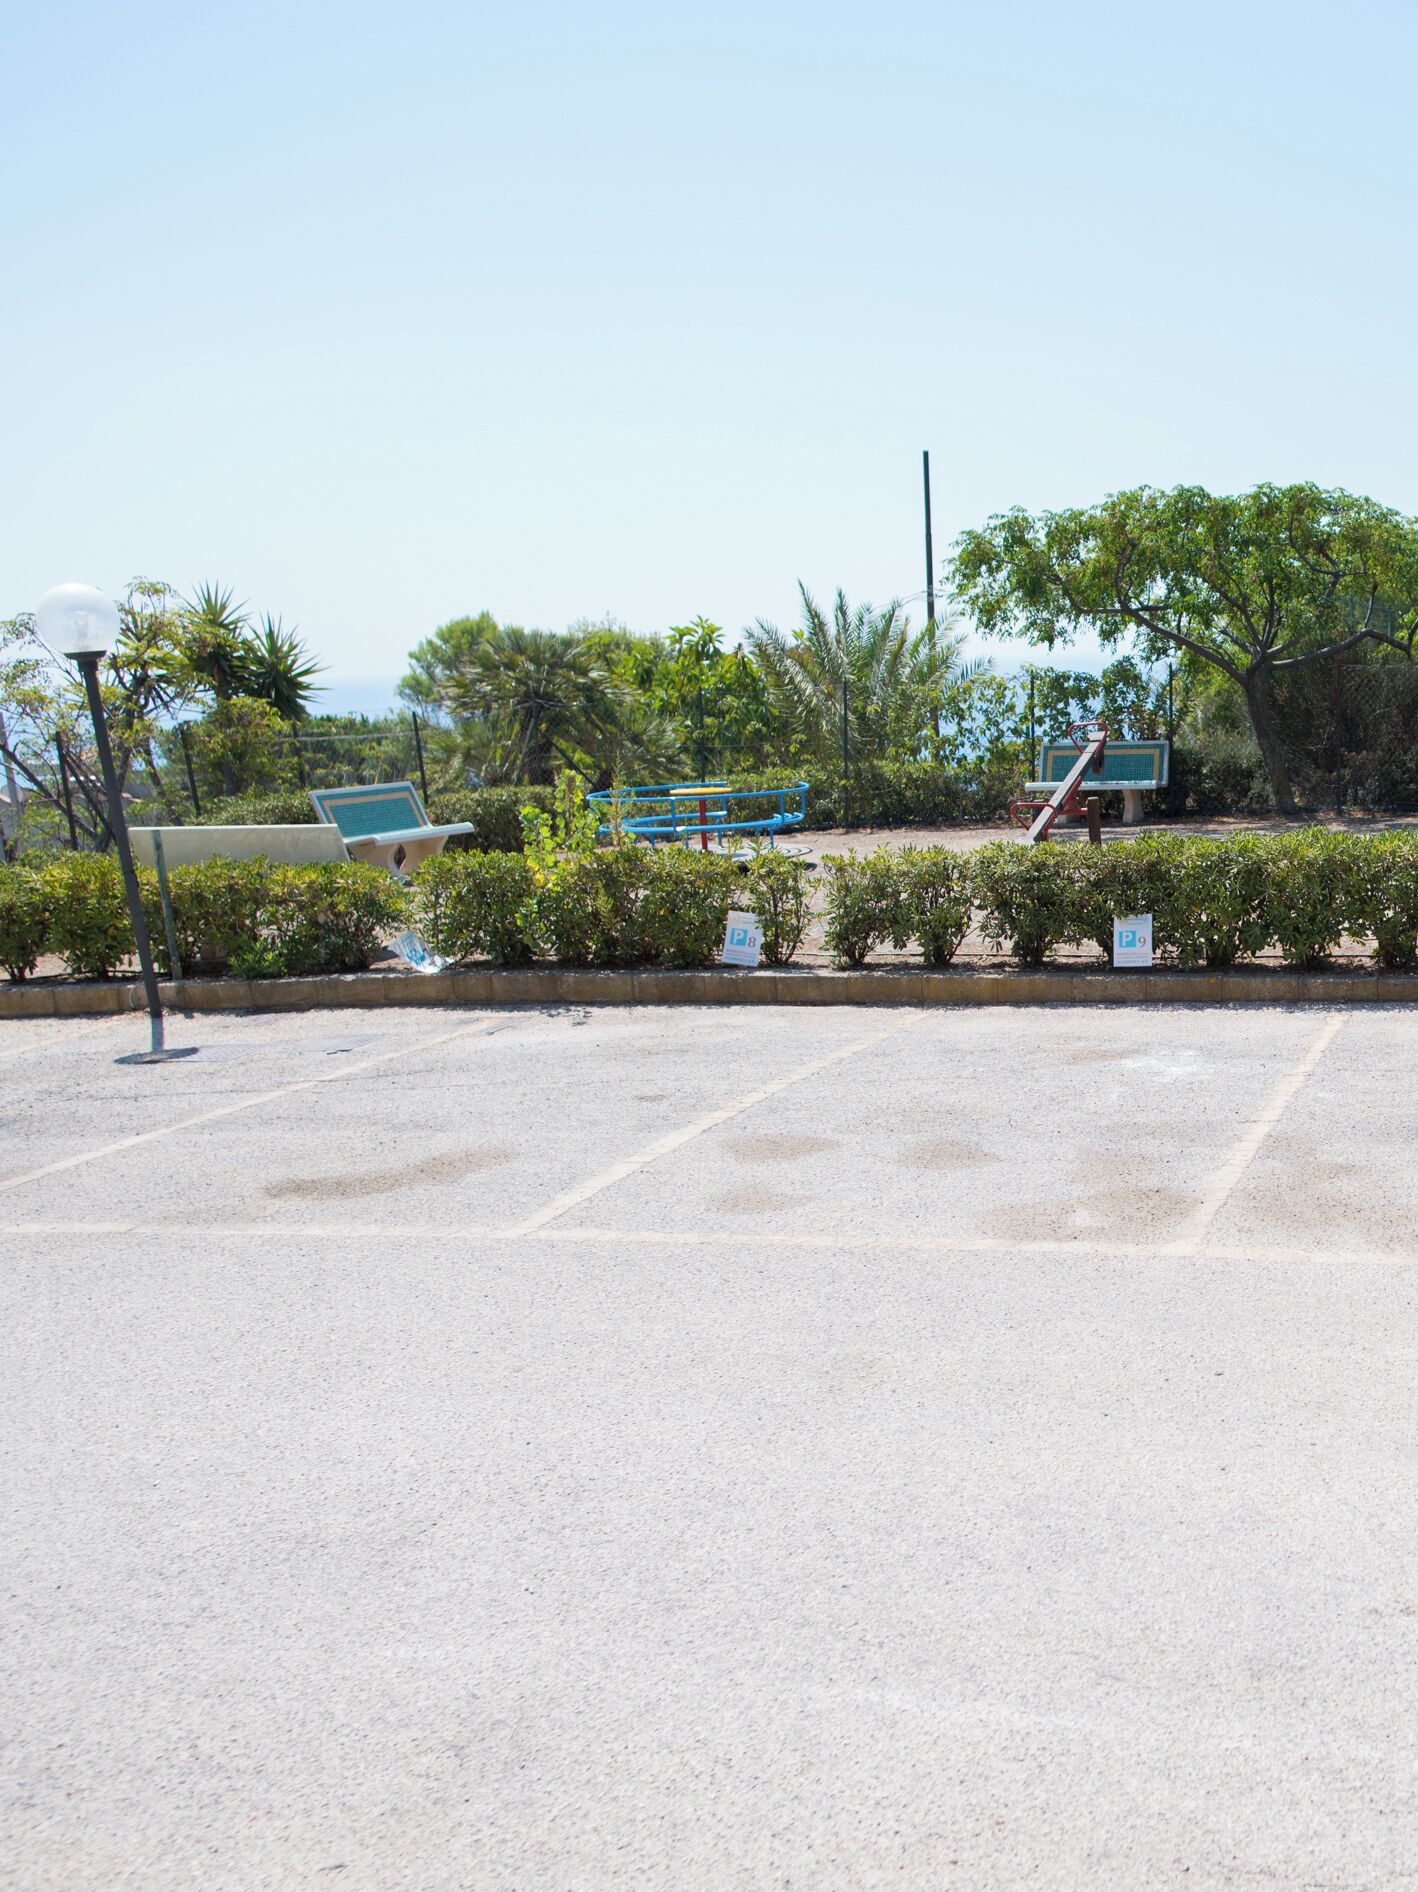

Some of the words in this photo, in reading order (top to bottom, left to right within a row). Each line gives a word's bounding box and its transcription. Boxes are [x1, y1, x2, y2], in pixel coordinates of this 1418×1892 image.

[734, 930, 744, 944] P
[748, 937, 756, 948] 8
[1122, 932, 1132, 946] P
[1138, 936, 1146, 948] 9
